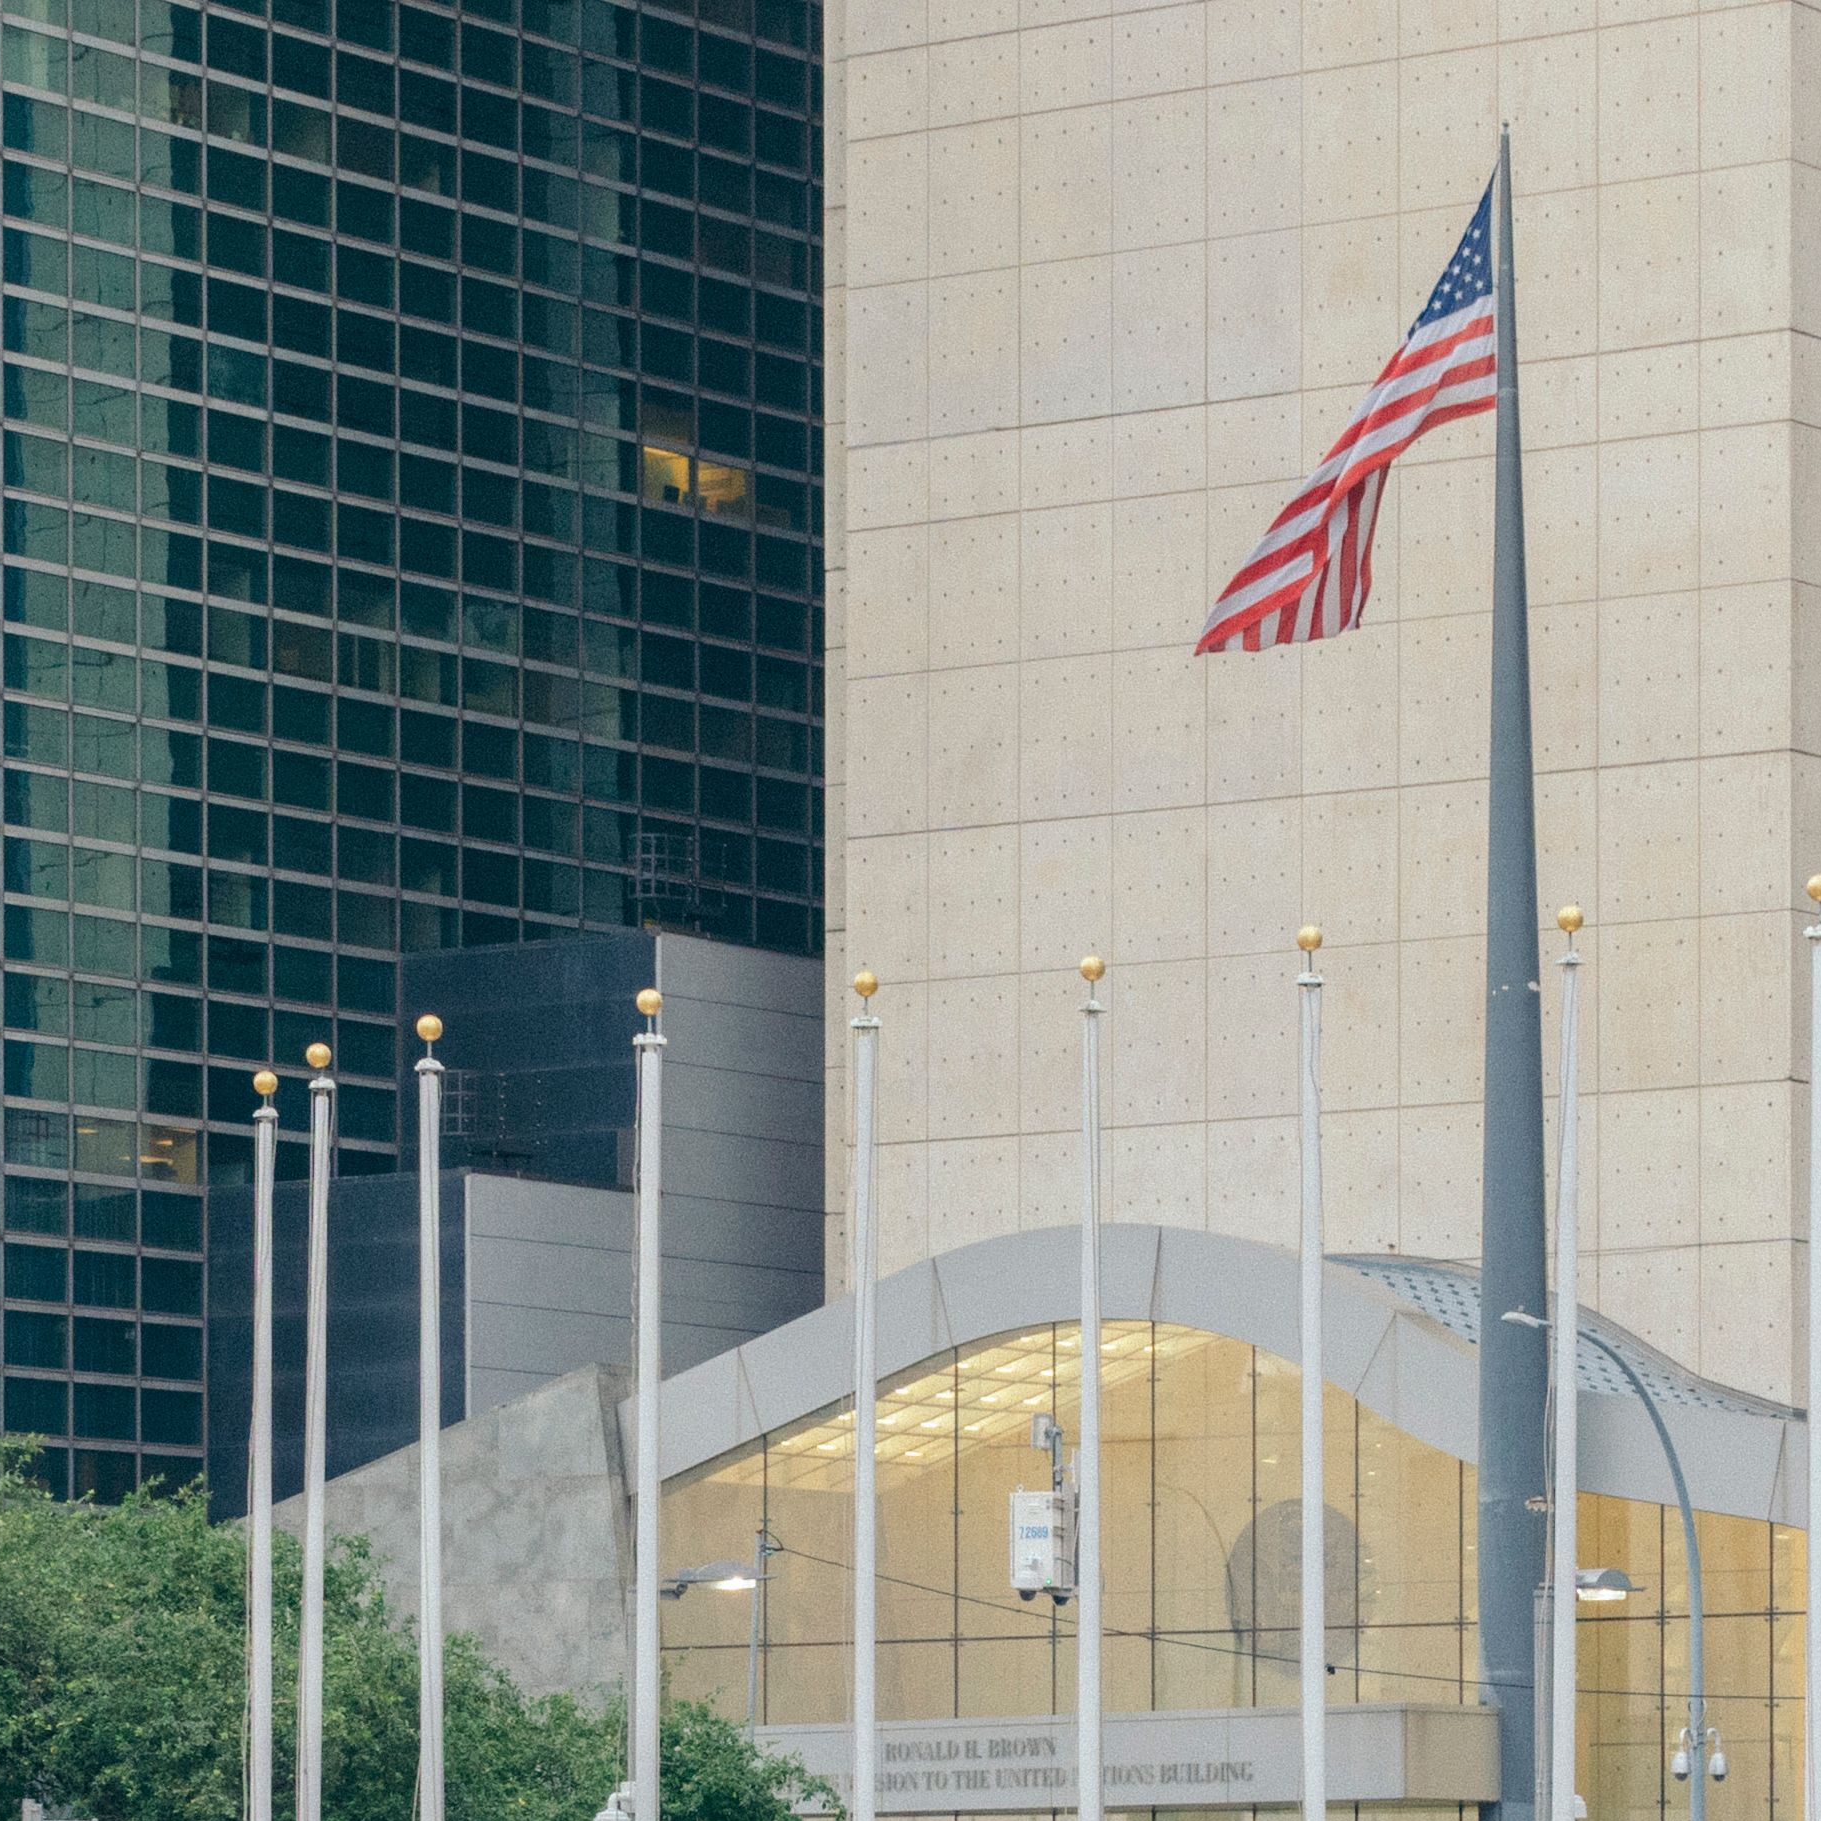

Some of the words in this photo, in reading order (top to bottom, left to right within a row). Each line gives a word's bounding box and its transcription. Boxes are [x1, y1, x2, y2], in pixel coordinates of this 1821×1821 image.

[884, 1740, 959, 1762] RONALD
[965, 1740, 983, 1760] H.
[988, 1736, 1057, 1758] BROWN
[921, 1769, 949, 1791] TO
[951, 1767, 990, 1790] THE
[994, 1767, 1067, 1789] UNITED
[1159, 1761, 1254, 1784] BUILDING
